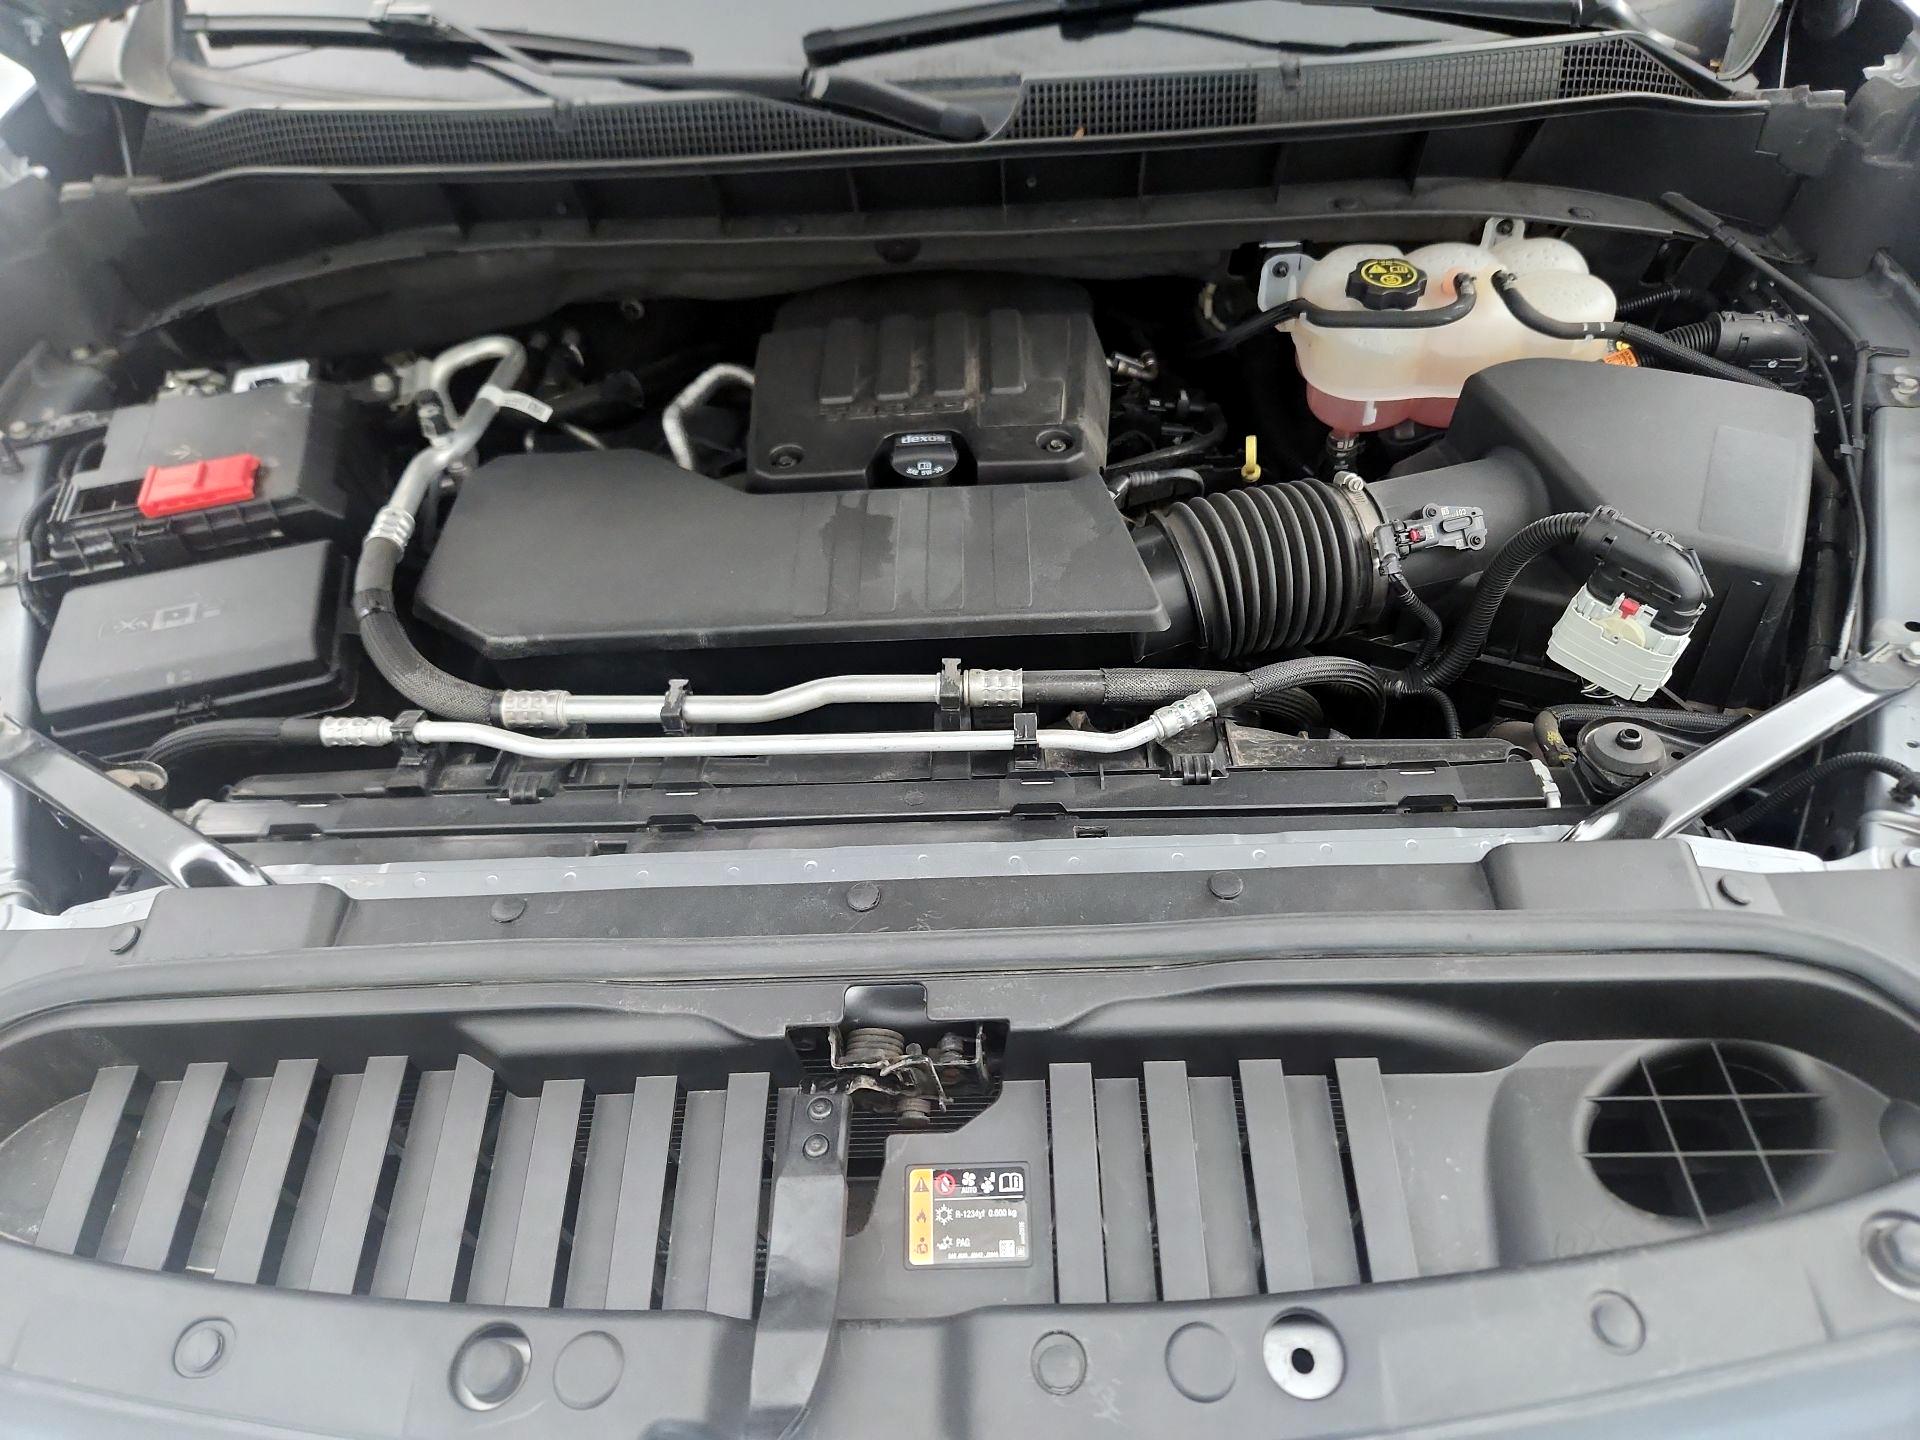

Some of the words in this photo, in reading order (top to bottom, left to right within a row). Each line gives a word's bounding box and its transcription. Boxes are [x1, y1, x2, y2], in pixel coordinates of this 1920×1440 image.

[901, 434, 946, 444] dexos
[961, 1186, 978, 1194] AUTO
[955, 1208, 985, 1219] R-1234yf
[955, 1237, 971, 1247] PAG
